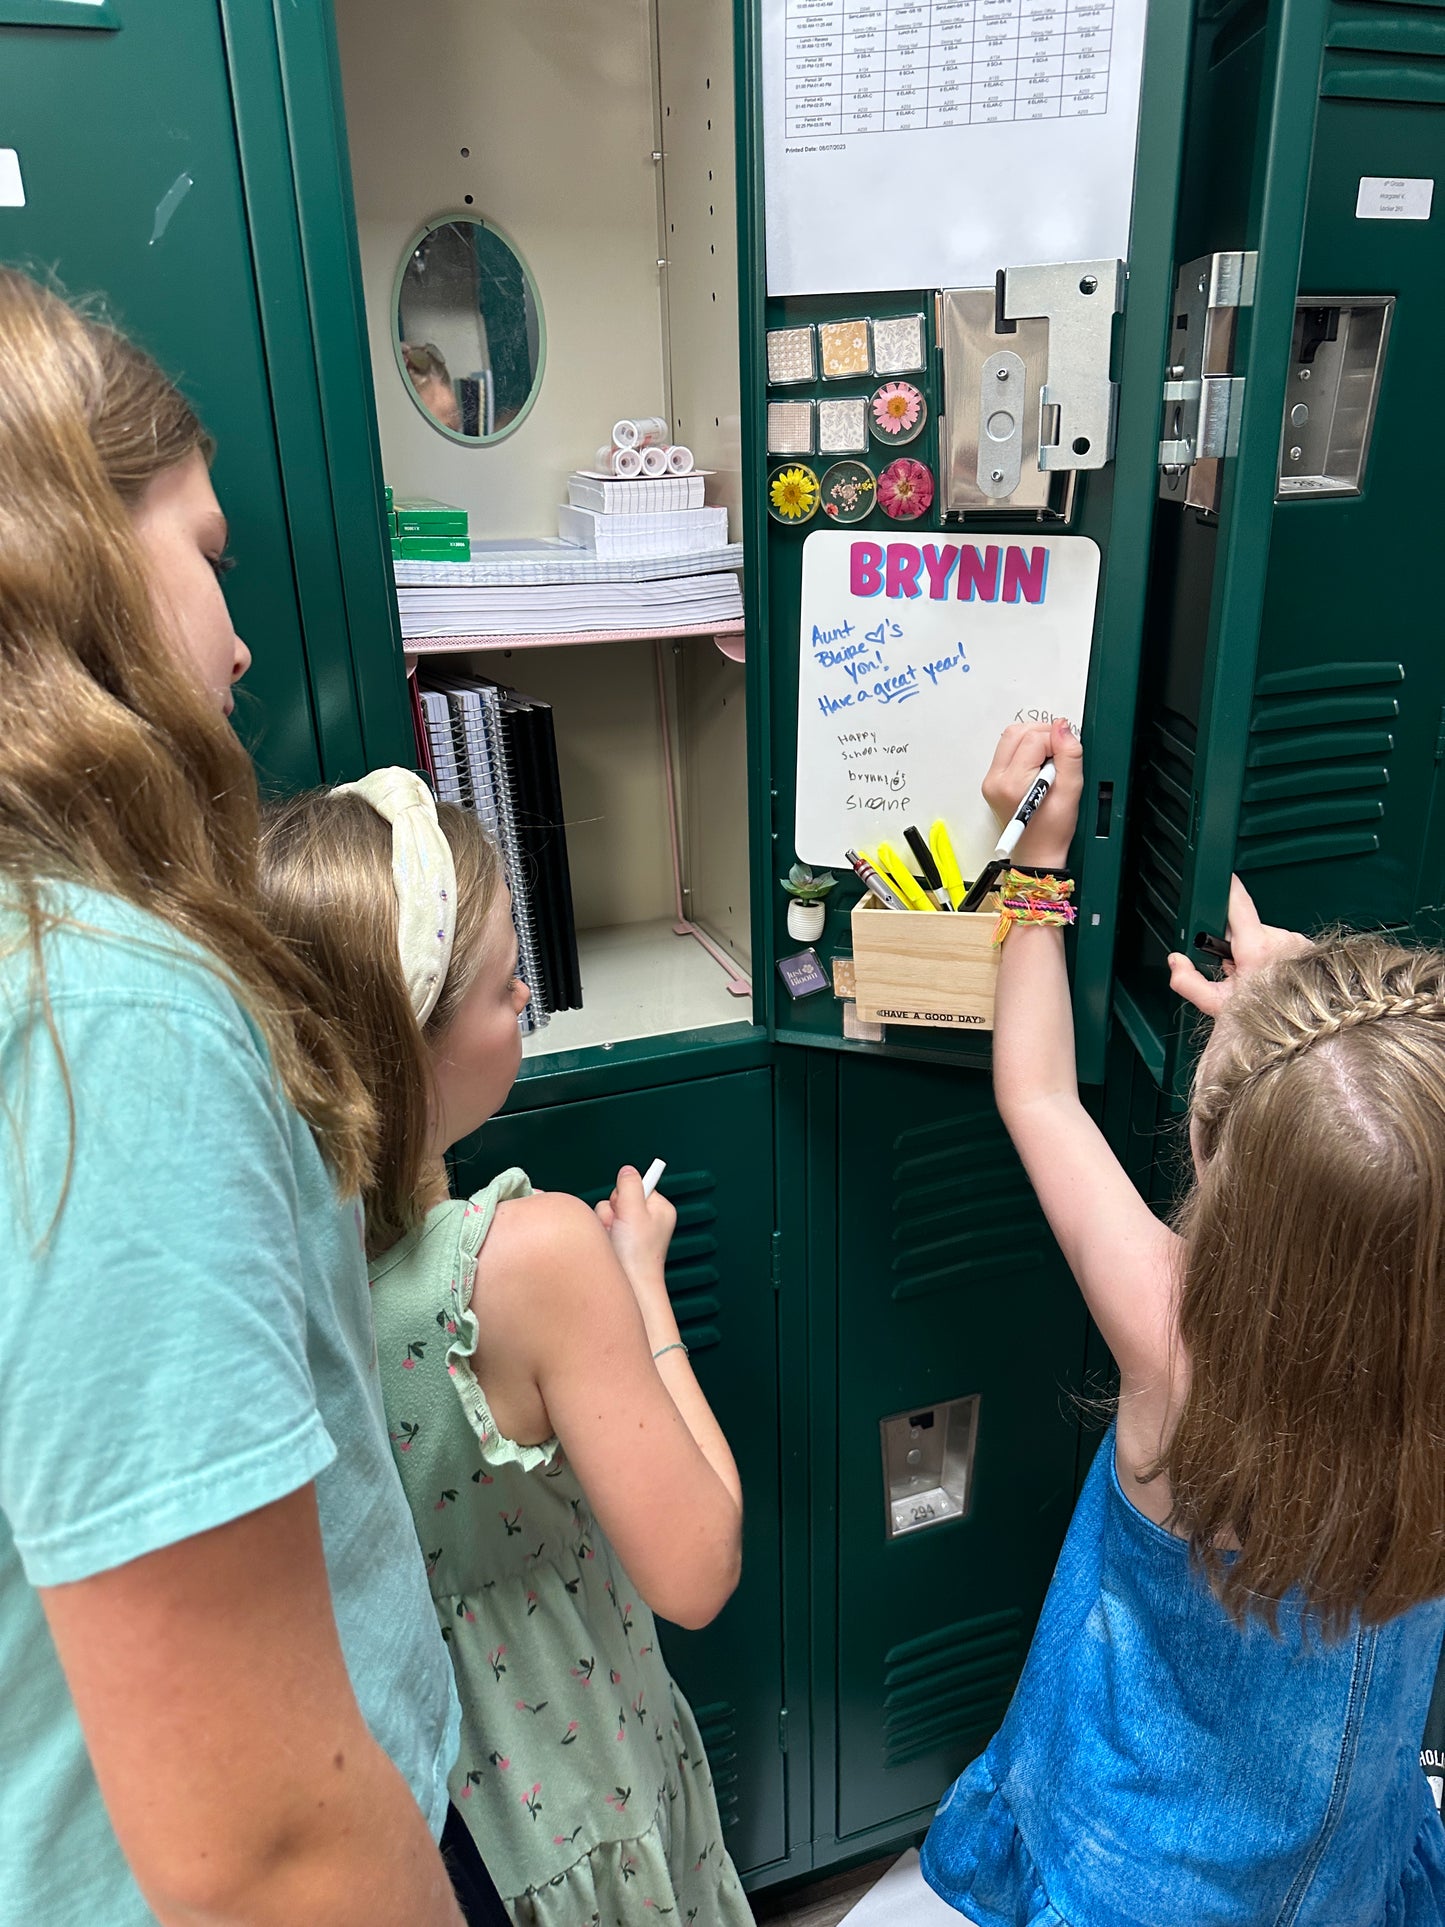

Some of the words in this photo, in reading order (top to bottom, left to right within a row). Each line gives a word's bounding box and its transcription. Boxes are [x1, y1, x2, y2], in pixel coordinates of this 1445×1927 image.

[850, 542, 1050, 604] BRYNN
[812, 619, 855, 647] Aunt
[814, 642, 869, 668] Blaire
[818, 694, 855, 717] Have
[857, 690, 873, 702] a
[874, 665, 918, 704] great
[923, 642, 970, 685] year!
[838, 732, 876, 745] Happy
[883, 743, 909, 754] year
[786, 968, 802, 979] Just
[790, 972, 818, 986] Bloom
[925, 1013, 953, 1021] GOOD
[910, 1504, 936, 1520] 294
